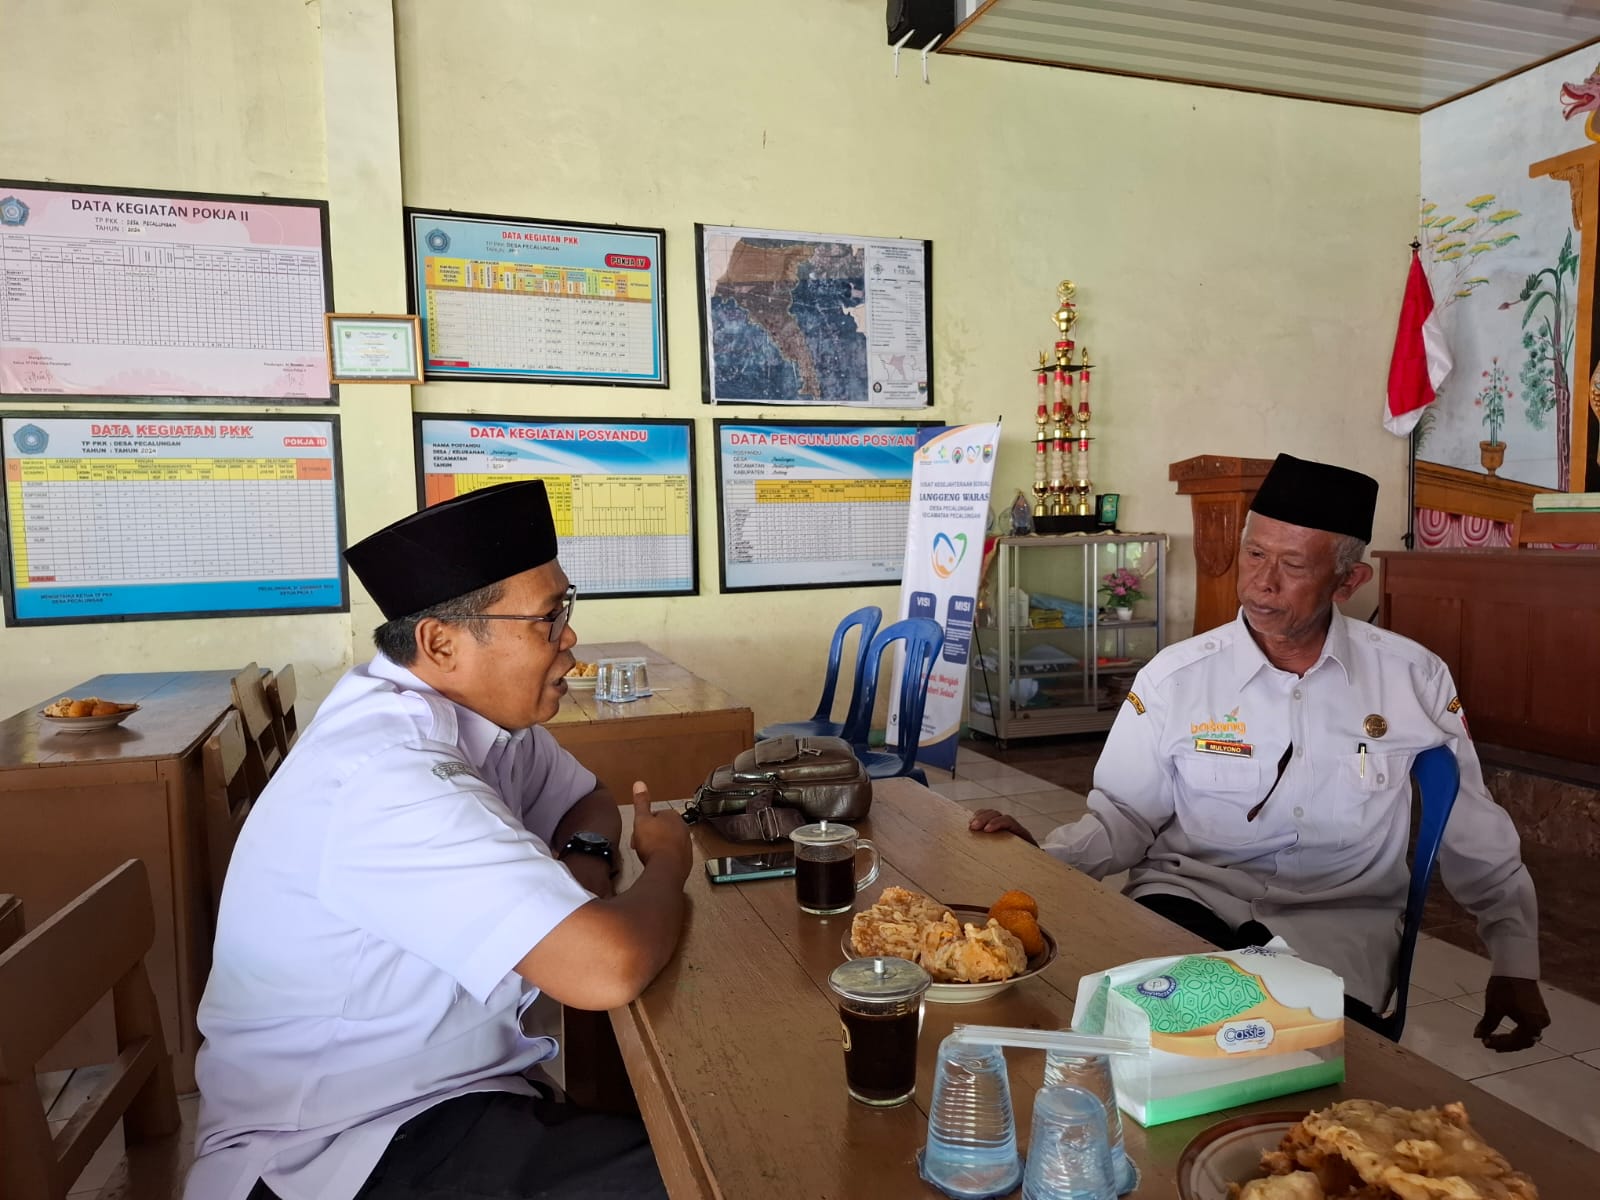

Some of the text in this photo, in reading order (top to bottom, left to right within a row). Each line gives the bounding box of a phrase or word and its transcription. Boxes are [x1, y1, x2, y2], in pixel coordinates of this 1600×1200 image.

[71, 199, 249, 221] DATA KEGIATAN POKJA II
[95, 224, 120, 233] TAHUN
[502, 231, 578, 245] DATA KEGIATAN PKK
[522, 244, 560, 252] PECALUNGAN
[611, 255, 646, 267] POKJA IV
[91, 424, 253, 438] DATA KEGIATAN PKK
[470, 426, 648, 442] DATA KEGIATAN POSYANDU
[284, 438, 326, 446] POKJA III
[730, 433, 767, 445] DATA
[771, 434, 860, 447] PENGUNJUNG
[962, 493, 989, 501] WARAS
[916, 597, 931, 607] VISI
[954, 601, 971, 612] MISI
[1209, 744, 1242, 753] MULYONO
[1223, 1024, 1266, 1043] Cassie
